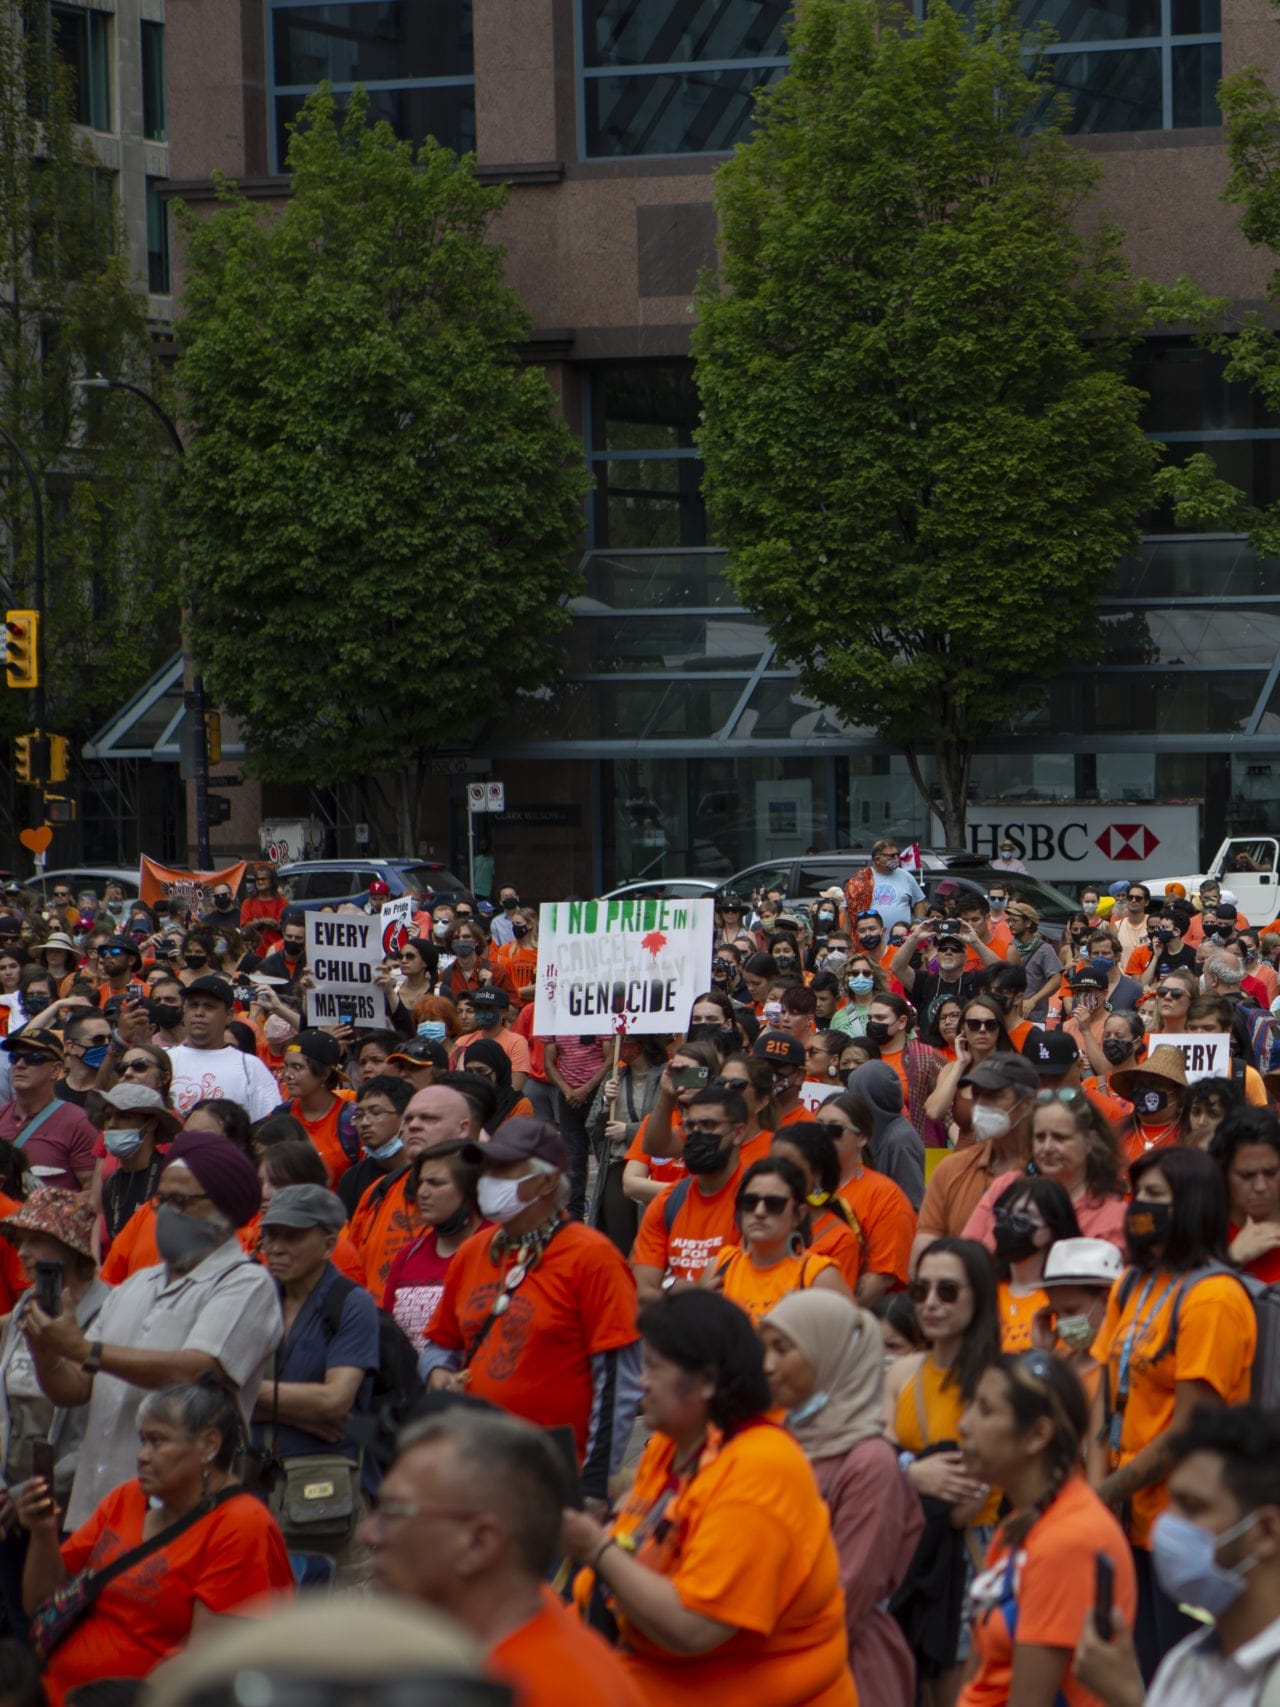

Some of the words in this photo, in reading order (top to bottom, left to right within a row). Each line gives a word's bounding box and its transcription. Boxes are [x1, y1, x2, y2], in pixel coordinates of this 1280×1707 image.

[968, 823, 1089, 862] HSBC
[393, 902, 409, 914] Pride
[568, 901, 599, 934] NO
[606, 900, 673, 933] PRIDE
[673, 908, 688, 930] IN
[314, 921, 369, 948] EVERY
[314, 958, 372, 984] CHILD
[314, 993, 375, 1019] MATRS
[570, 978, 676, 1016] GENOCIDE
[765, 1040, 792, 1057] 215
[1039, 1043, 1050, 1059] LA
[1182, 1044, 1218, 1071] ERY
